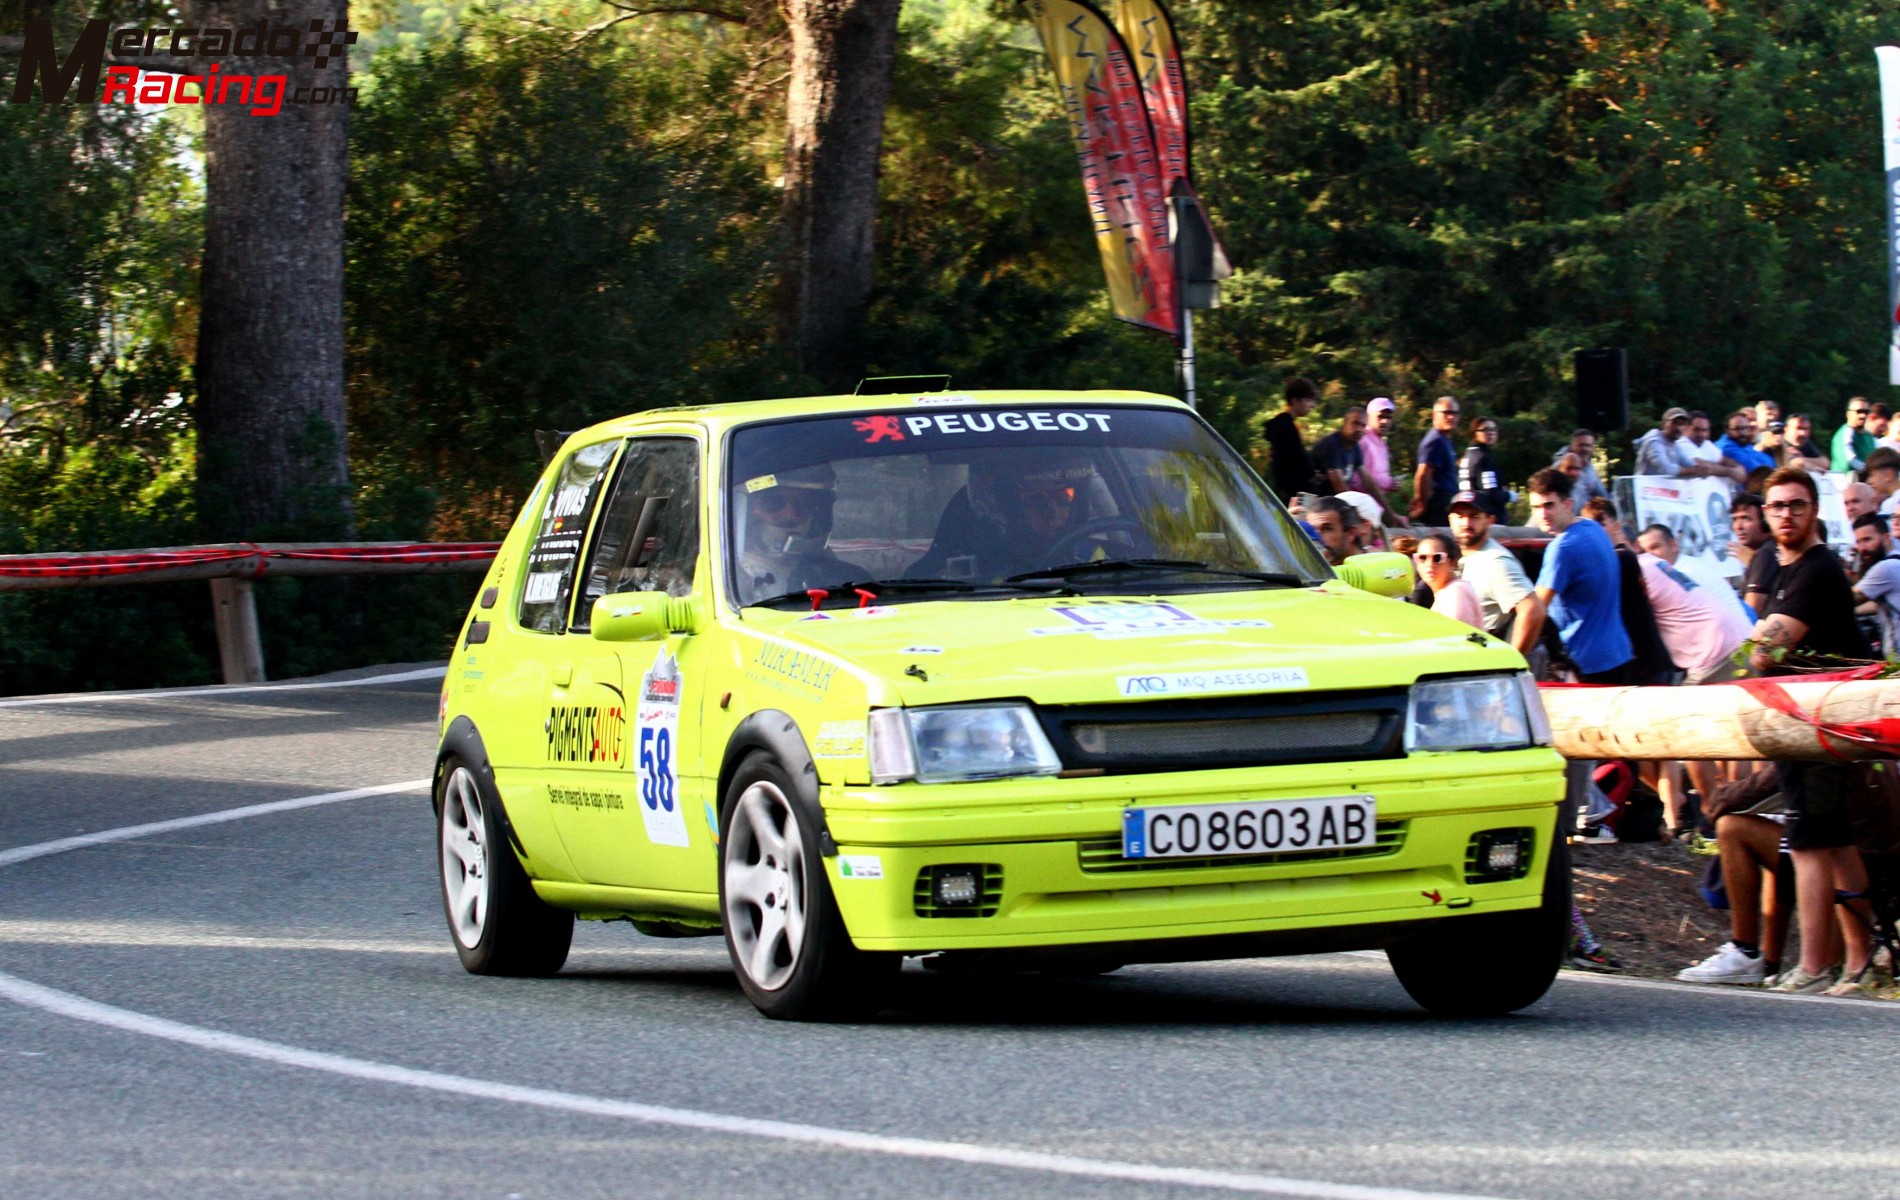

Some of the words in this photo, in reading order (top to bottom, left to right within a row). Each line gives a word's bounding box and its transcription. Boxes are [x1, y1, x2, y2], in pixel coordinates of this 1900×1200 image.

[905, 411, 1112, 436] PEUGEOT
[546, 706, 621, 763] PIGMENTSAUTO
[640, 727, 674, 813] 58
[1130, 842, 1141, 853] E
